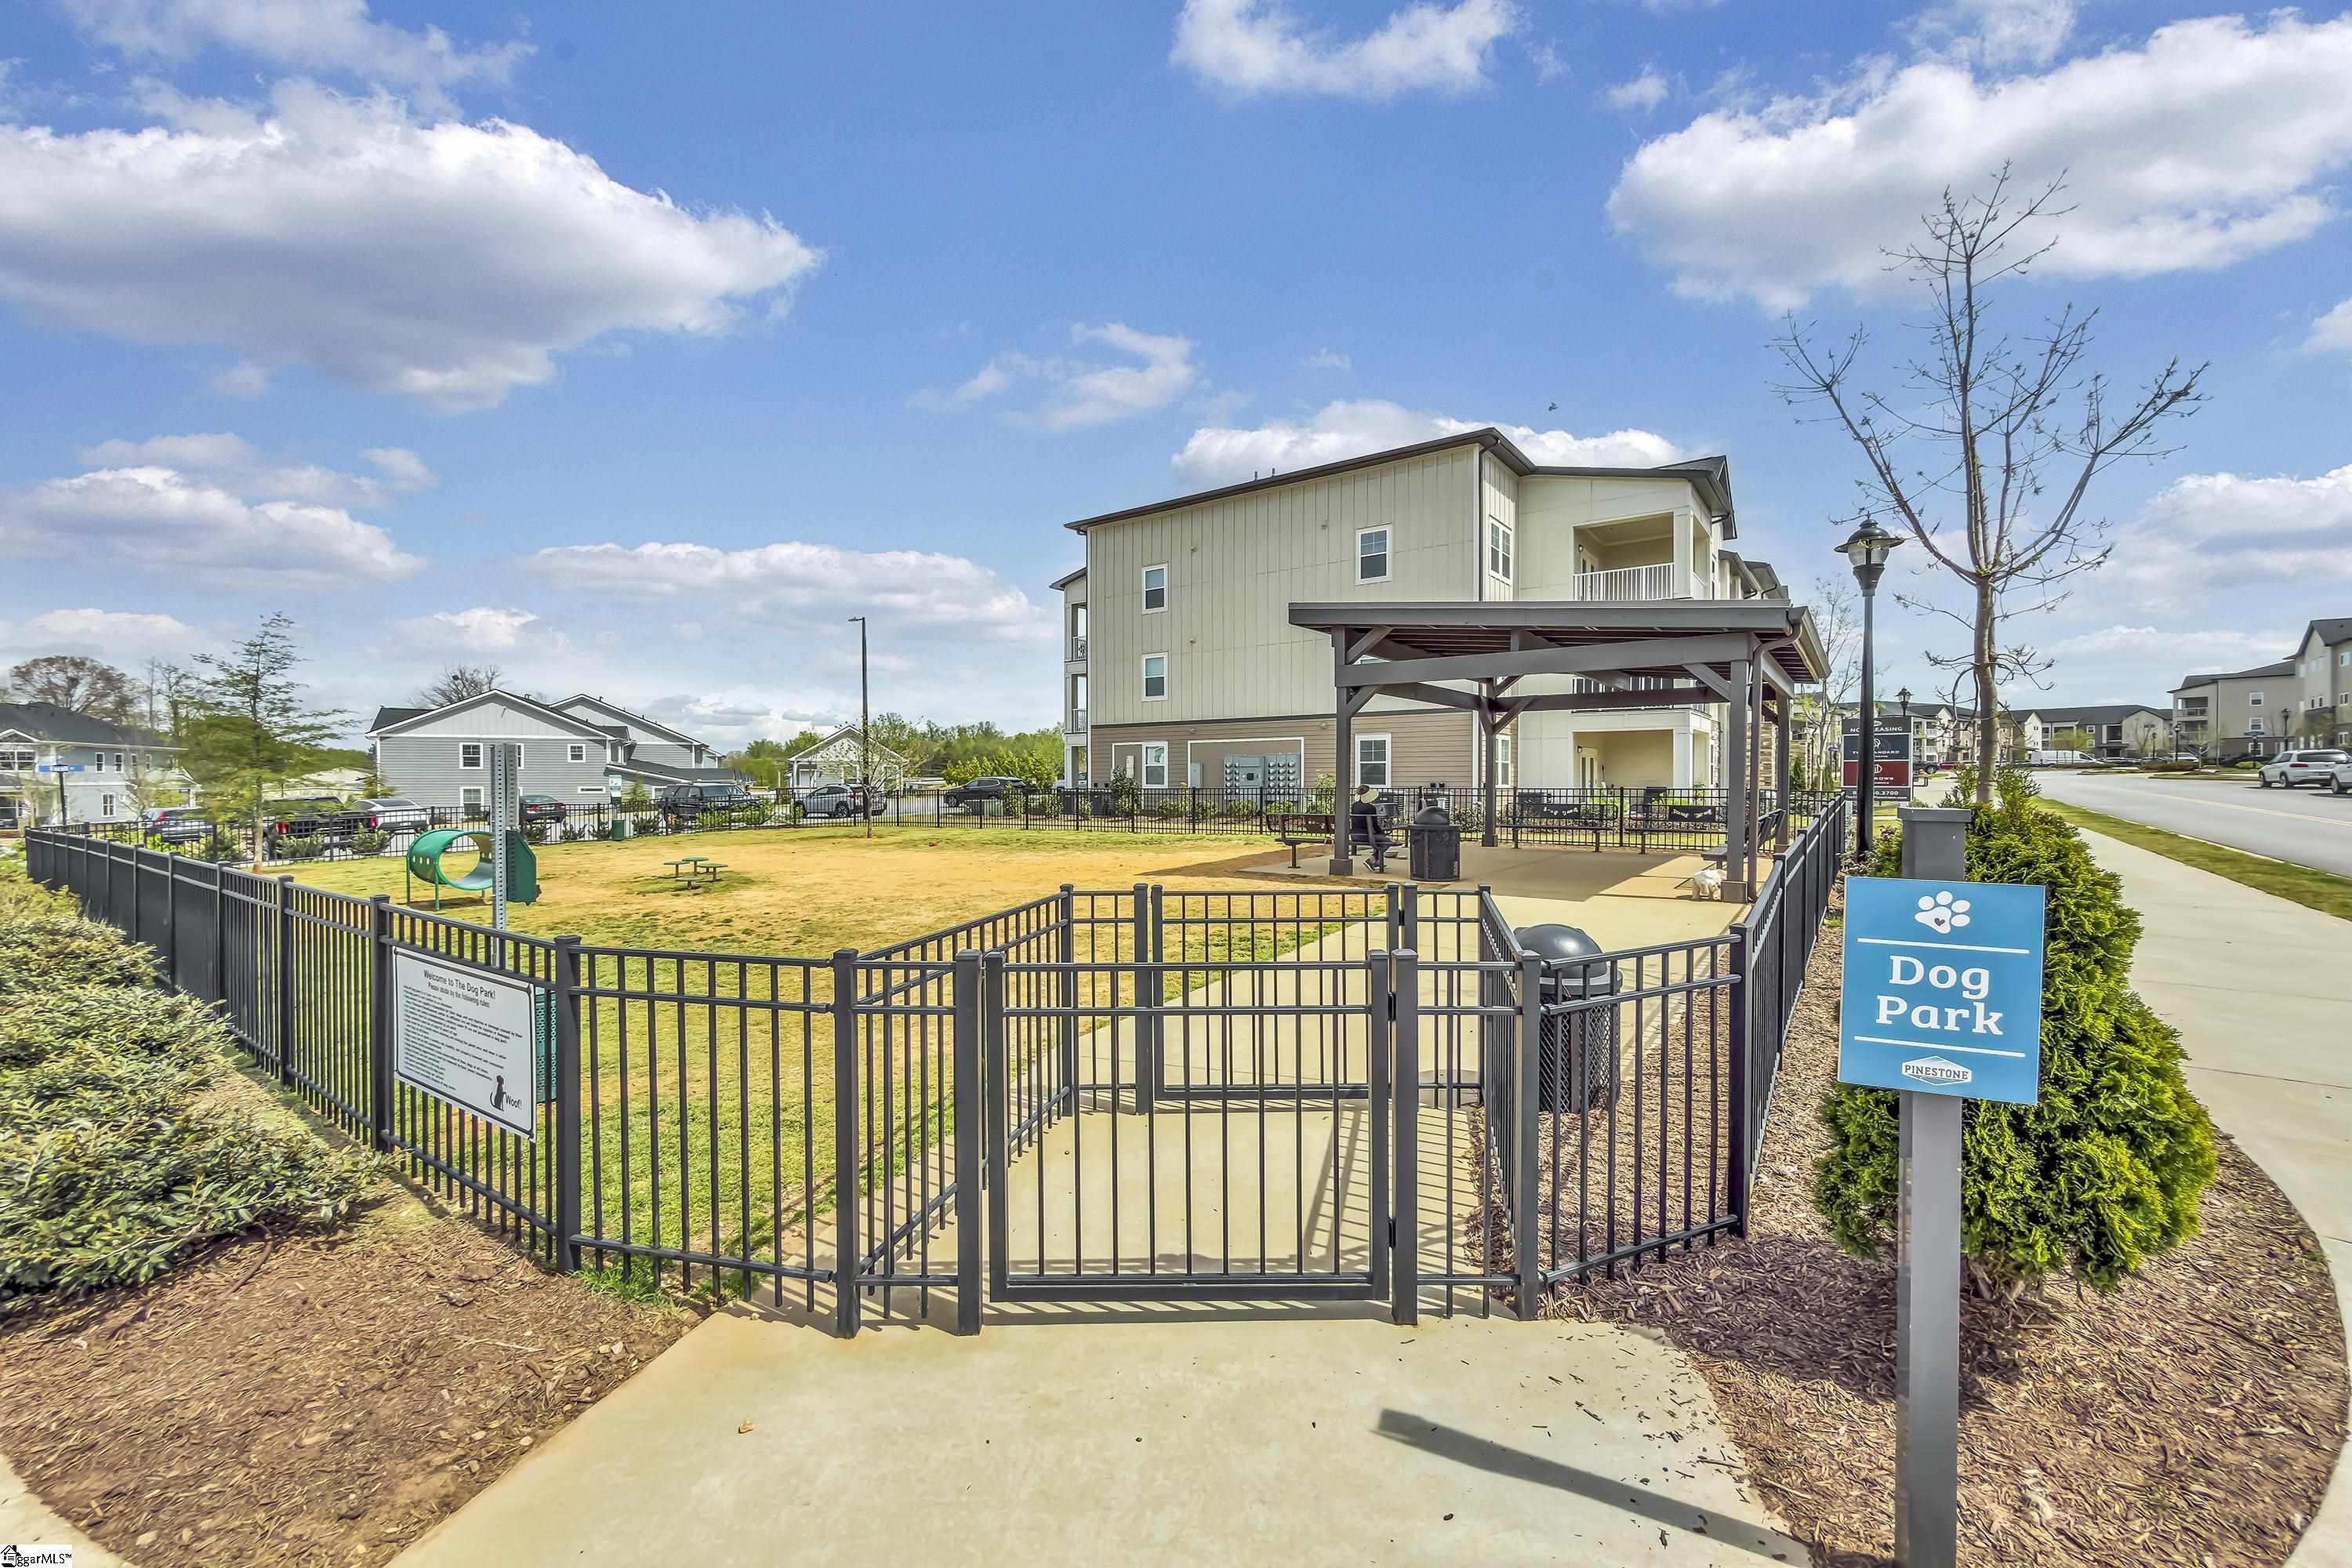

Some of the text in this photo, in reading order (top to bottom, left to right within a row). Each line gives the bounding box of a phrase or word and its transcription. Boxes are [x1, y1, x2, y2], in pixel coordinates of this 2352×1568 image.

[423, 969, 495, 1000] Welcome to The Dog Park!
[1889, 955, 1989, 1000] Dog
[1875, 995, 2003, 1035] Park
[1904, 1065, 1969, 1080] PINESTONE
[506, 1094, 522, 1110] Woof!
